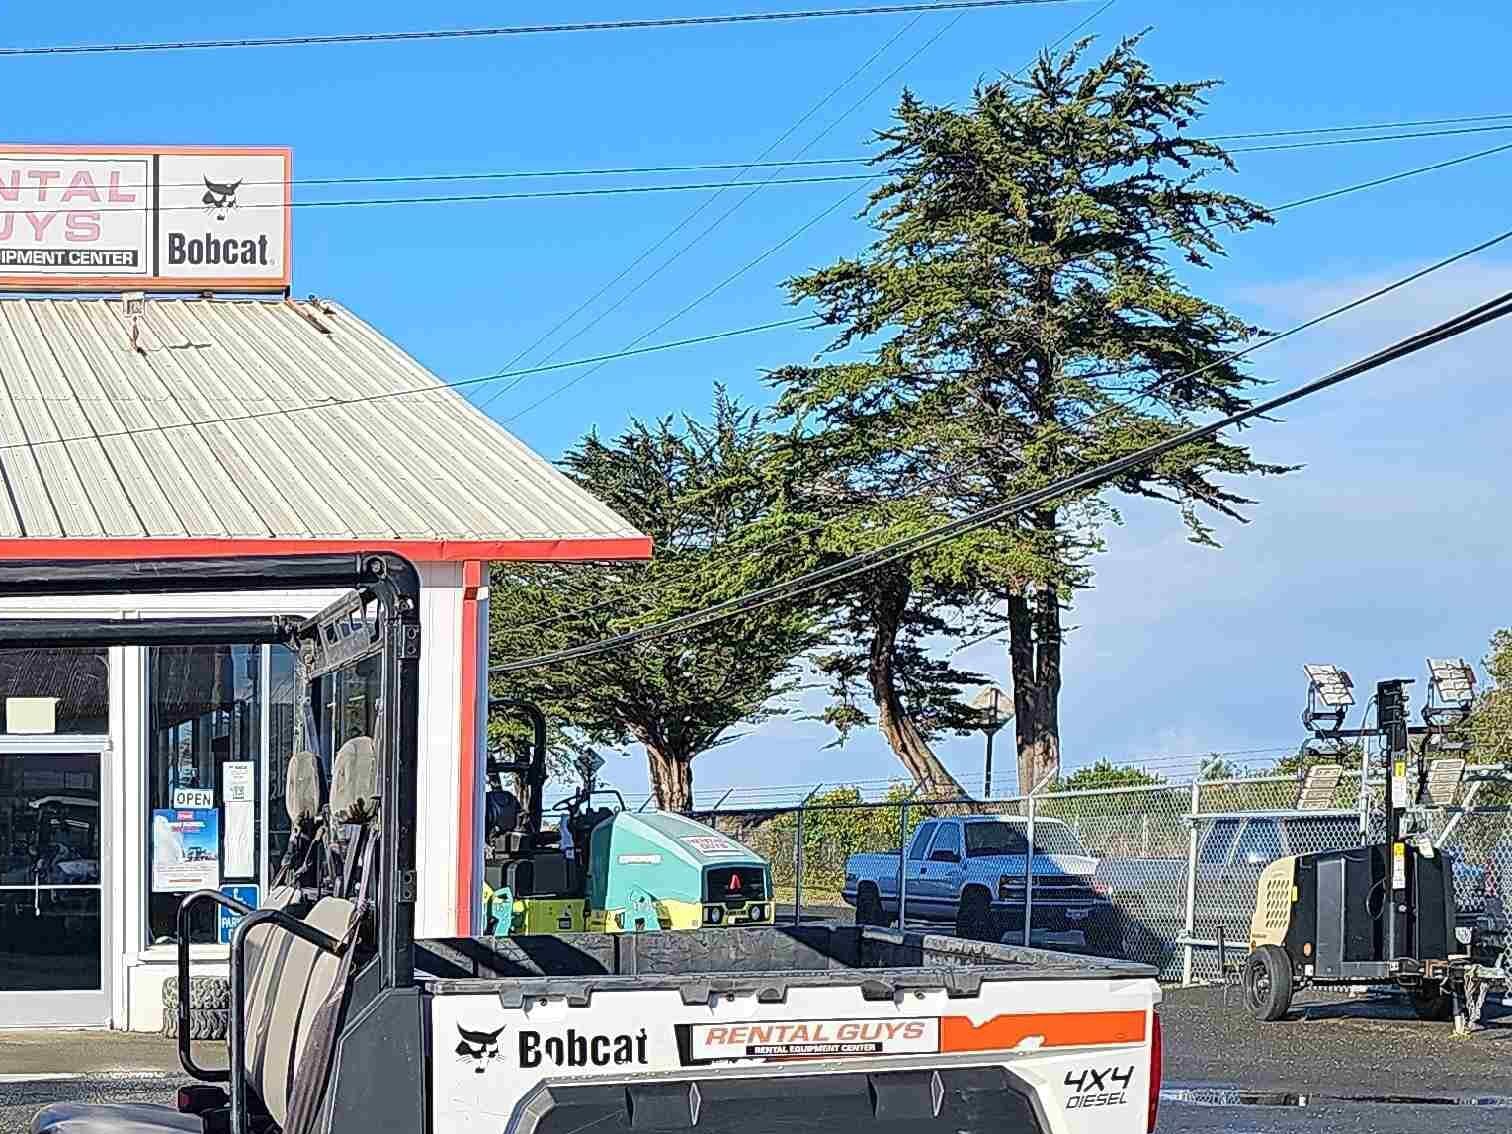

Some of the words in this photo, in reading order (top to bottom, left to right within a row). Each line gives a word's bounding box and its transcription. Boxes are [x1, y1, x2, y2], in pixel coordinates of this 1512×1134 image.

[69, 250, 134, 265] CENTER
[168, 232, 268, 265] Bobcat
[176, 792, 211, 806] OPEN
[705, 1024, 829, 1046] RENTAL
[836, 1022, 926, 1041] GUYS
[519, 1027, 648, 1068] Bobcat
[754, 1044, 789, 1054] RENTAL
[789, 1043, 840, 1053] EQUIPMENT
[841, 1043, 876, 1052] CENTER
[1064, 1065, 1135, 1093] 4X4
[1065, 1092, 1128, 1110] DIESEL
